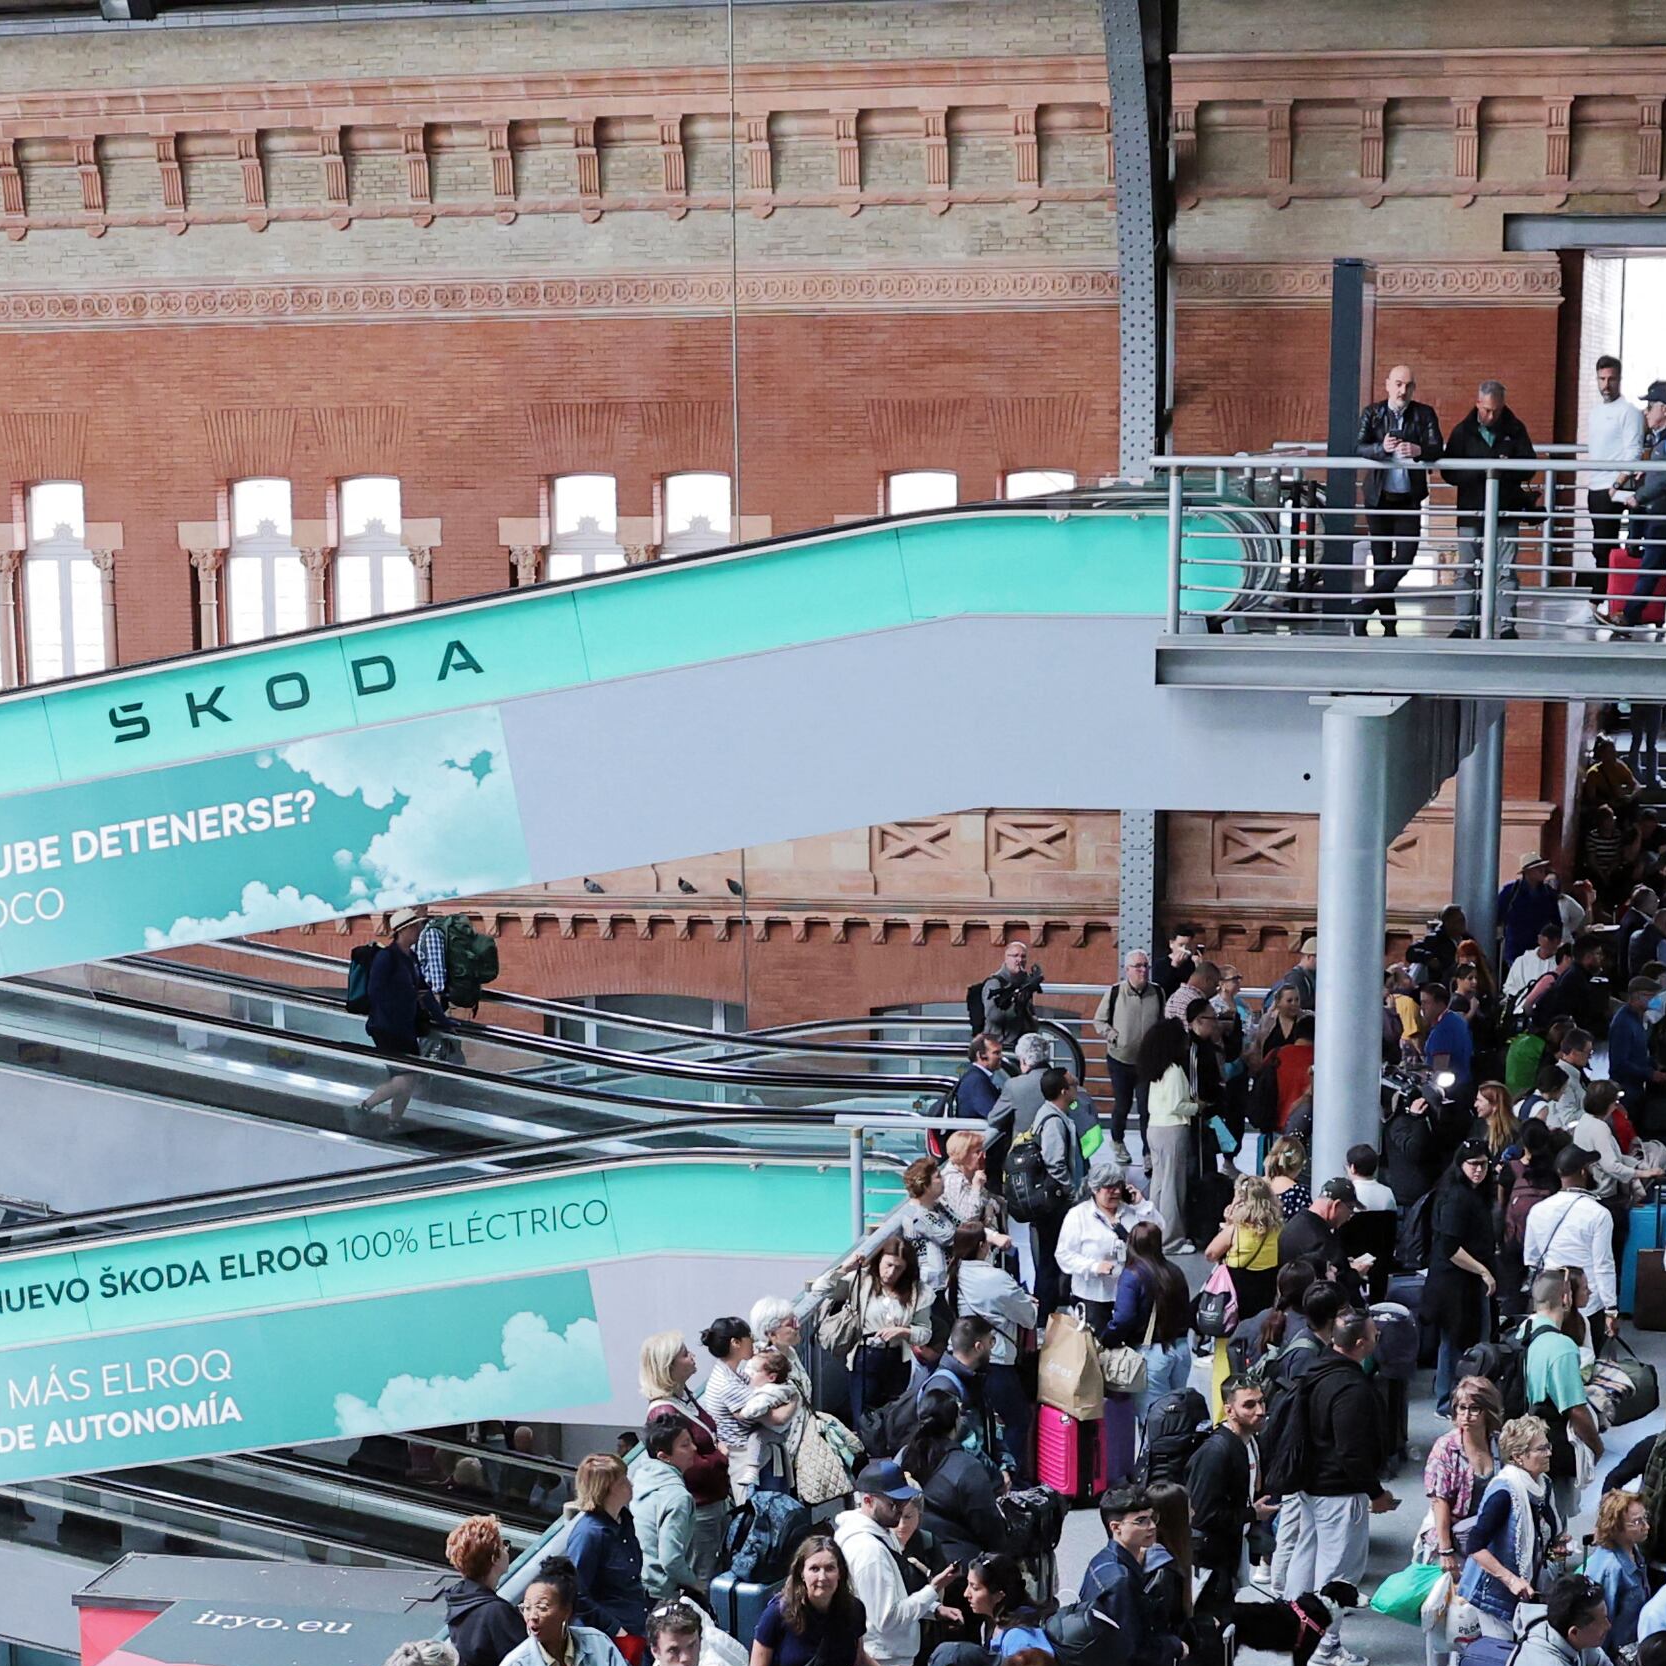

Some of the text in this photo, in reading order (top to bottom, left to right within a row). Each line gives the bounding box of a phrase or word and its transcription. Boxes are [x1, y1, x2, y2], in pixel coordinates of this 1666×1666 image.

[71, 789, 317, 864] DETENERSE?
[99, 1259, 211, 1299] ŠKODA
[220, 1241, 329, 1281] ELROQ
[336, 1226, 419, 1263] 100%
[428, 1199, 609, 1250] ELÉCTRICO
[8, 1364, 91, 1409] MÁS
[101, 1349, 233, 1397] ELROQ
[44, 1392, 243, 1447] AUTONOMÍA
[191, 1610, 353, 1635] iryo.eu
